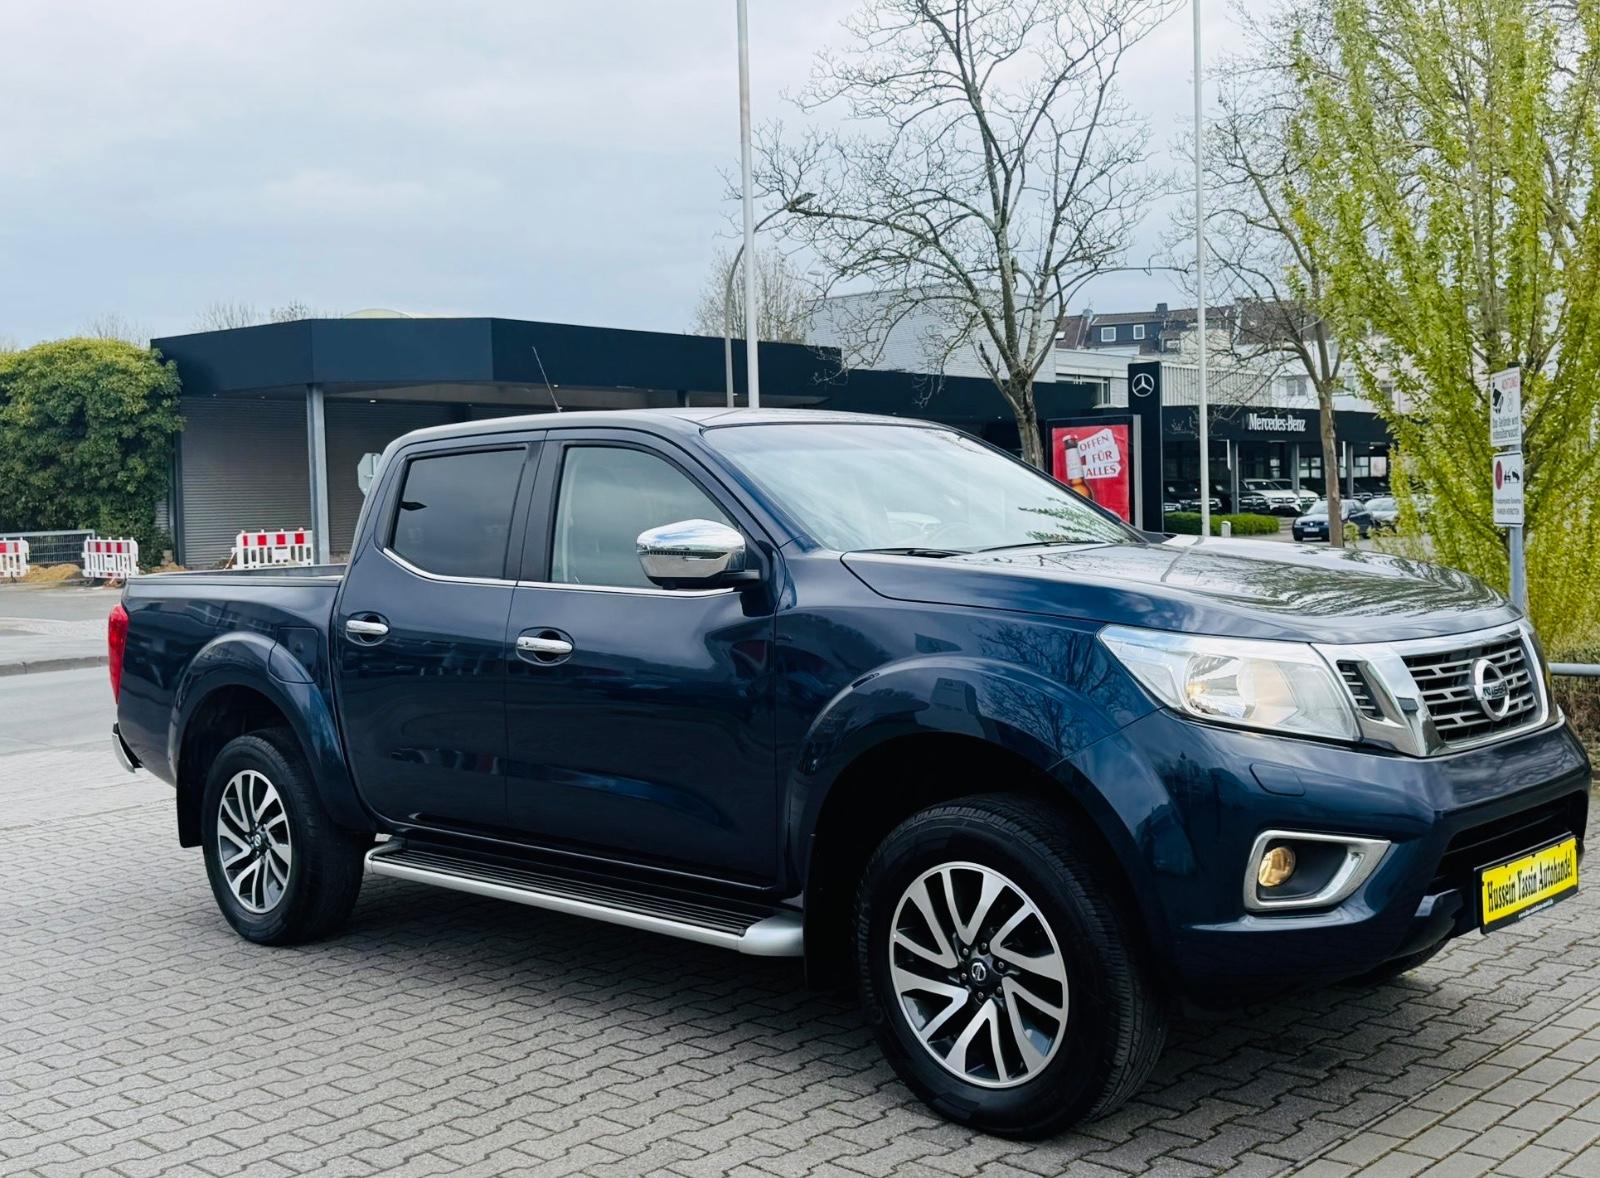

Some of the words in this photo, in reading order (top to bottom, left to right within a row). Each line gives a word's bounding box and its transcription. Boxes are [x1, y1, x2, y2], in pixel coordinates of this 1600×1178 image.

[1248, 412, 1306, 433] Mercedes-Benz
[1079, 433, 1109, 452] OFFEN
[1092, 449, 1113, 464] FÜR
[1085, 464, 1117, 478] ALLES
[1487, 876, 1516, 913] Hussein
[1517, 866, 1538, 900] Yassin
[1538, 850, 1573, 892] Autohandel
